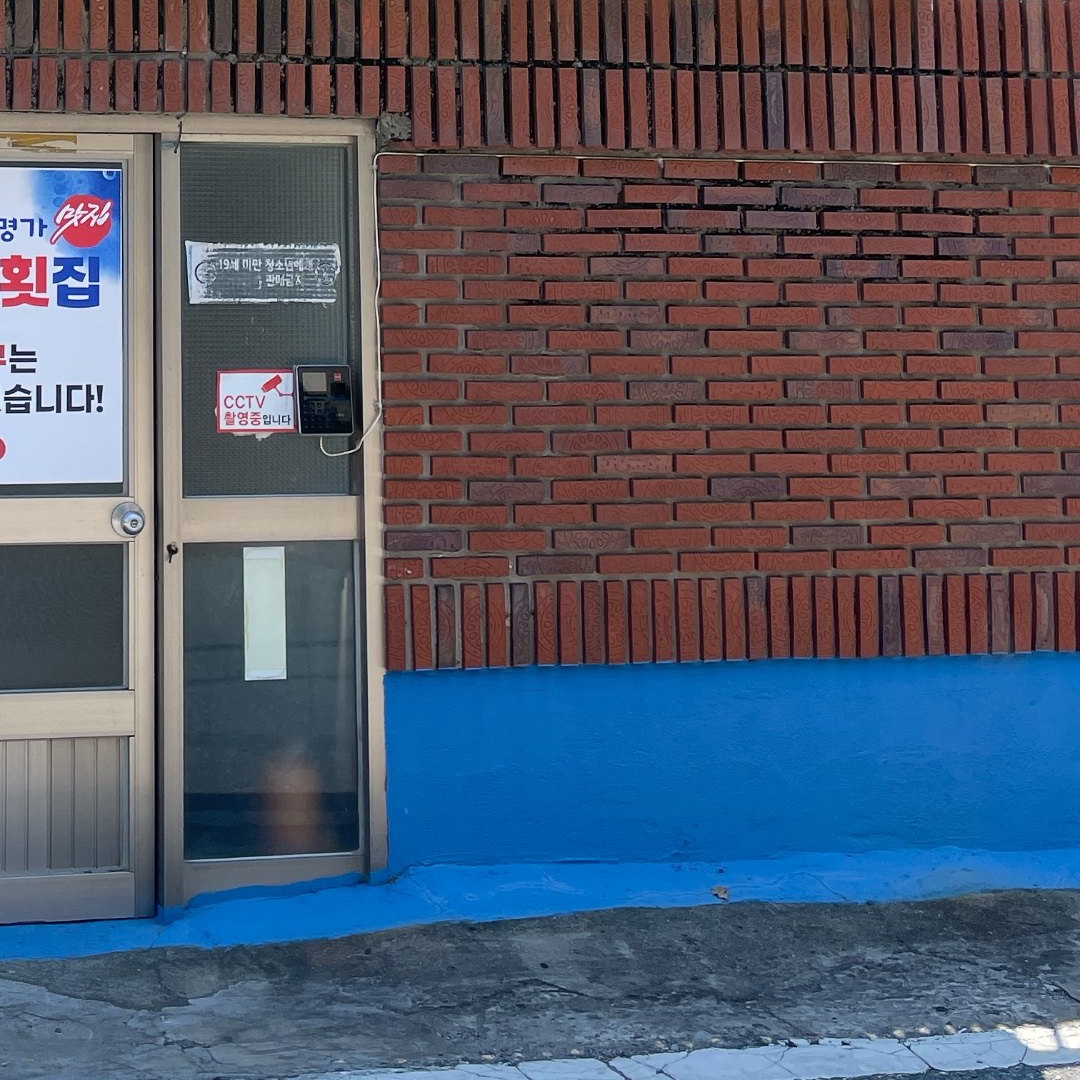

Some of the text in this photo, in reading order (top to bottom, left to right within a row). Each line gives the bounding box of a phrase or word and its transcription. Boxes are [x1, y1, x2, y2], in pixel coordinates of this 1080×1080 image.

[50, 201, 112, 244] 맛집
[218, 258, 239, 272] 19세
[242, 258, 262, 272] 미만
[224, 395, 266, 409] CCTV
[224, 411, 291, 426] 촬영중입니다
